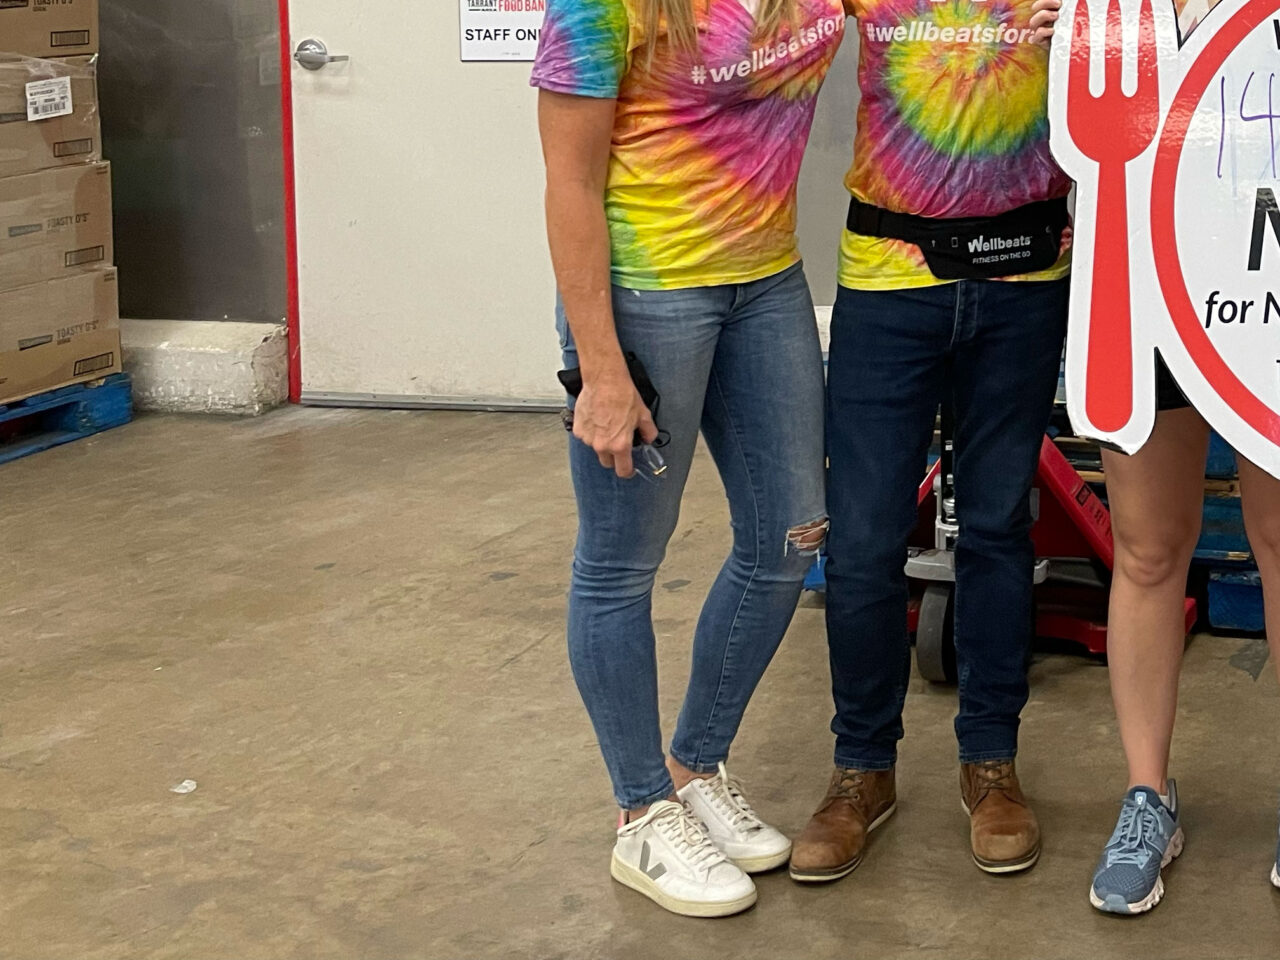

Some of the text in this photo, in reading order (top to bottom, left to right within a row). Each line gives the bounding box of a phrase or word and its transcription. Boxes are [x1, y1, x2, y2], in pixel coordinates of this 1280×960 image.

[498, 0, 523, 11] FOOD
[525, 0, 544, 11] BAN
[465, 29, 541, 40] STAFF ON
[968, 235, 1031, 253] Wellbeats
[972, 255, 999, 264] FITNESS
[1205, 291, 1254, 328] for
